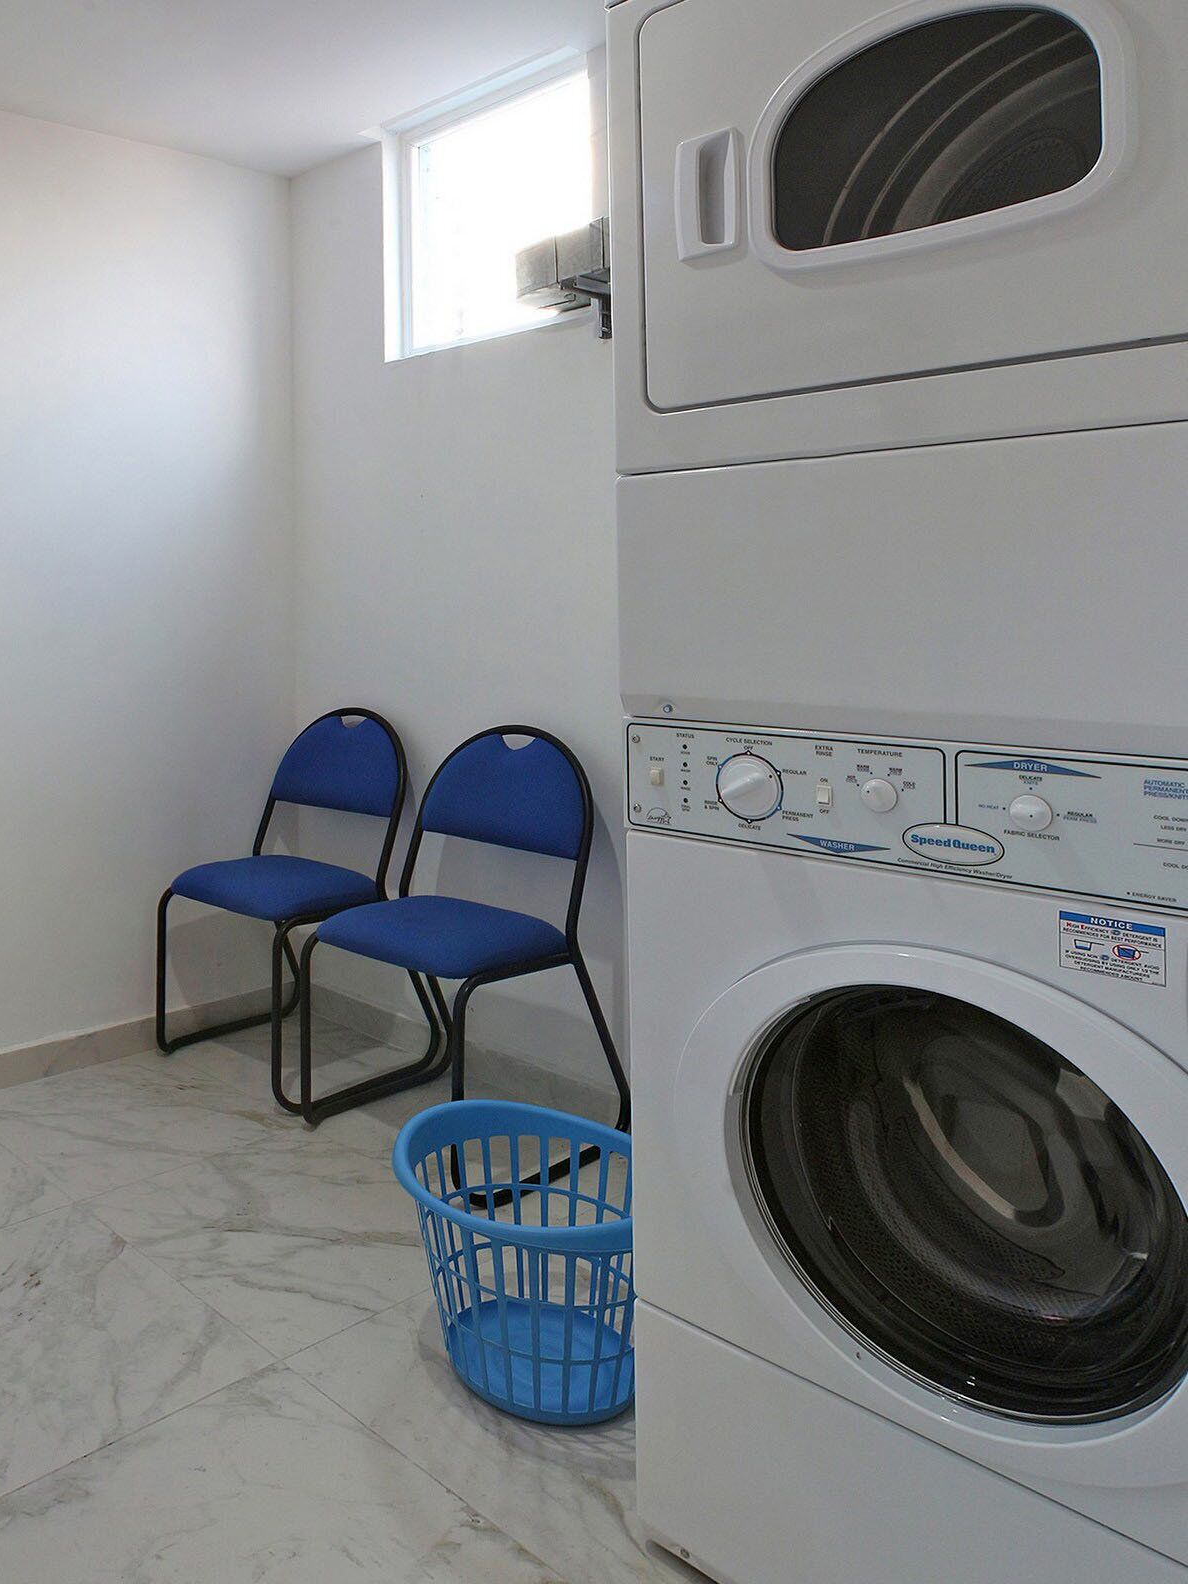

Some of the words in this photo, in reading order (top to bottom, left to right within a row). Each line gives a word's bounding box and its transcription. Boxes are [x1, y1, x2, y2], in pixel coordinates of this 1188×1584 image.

[744, 738, 773, 746] SELECTION
[857, 748, 903, 757] TEMPERATURE
[1013, 761, 1048, 772] DRYER
[782, 810, 813, 819] PERMANENT
[1003, 829, 1026, 837] FABRIC
[1027, 830, 1060, 840] SELECTOR
[819, 840, 855, 851] WASHER
[897, 857, 929, 867] Commercial
[944, 864, 972, 874] Efficiency
[1132, 892, 1156, 900] ENERGY
[1090, 917, 1133, 930] NOTICE
[1123, 932, 1151, 942] DETERGENT
[1124, 938, 1162, 949] PERFORMANCE
